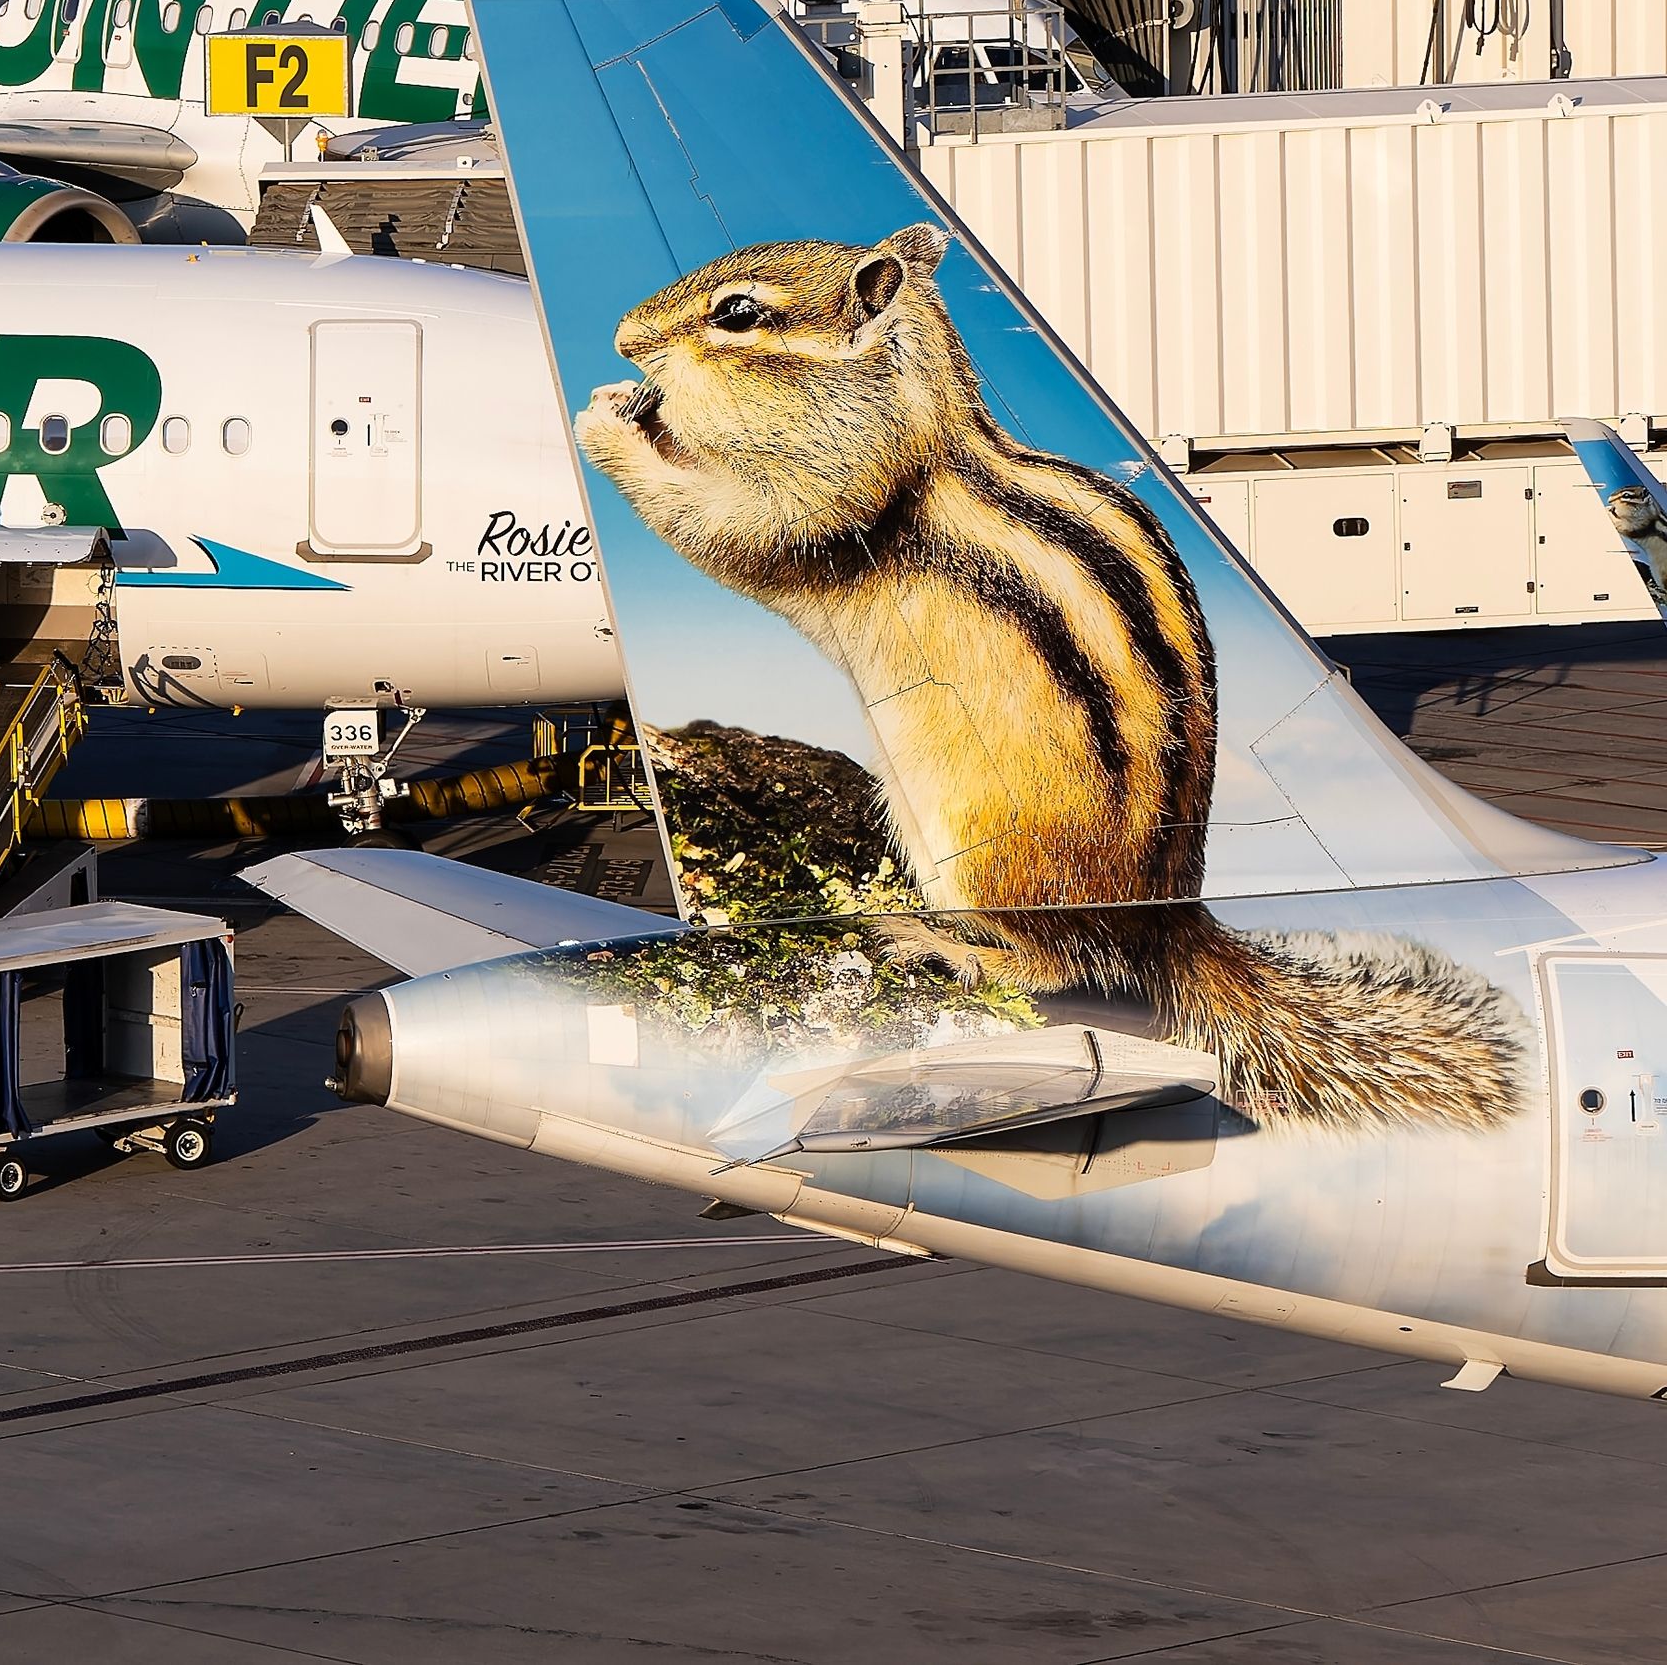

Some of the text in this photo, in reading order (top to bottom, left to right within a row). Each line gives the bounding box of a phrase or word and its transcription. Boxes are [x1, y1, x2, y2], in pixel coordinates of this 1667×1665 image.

[245, 43, 309, 108] F2
[477, 510, 594, 556] Rosie
[446, 560, 475, 573] THE
[480, 561, 562, 582] RIVER
[330, 725, 372, 742] 336
